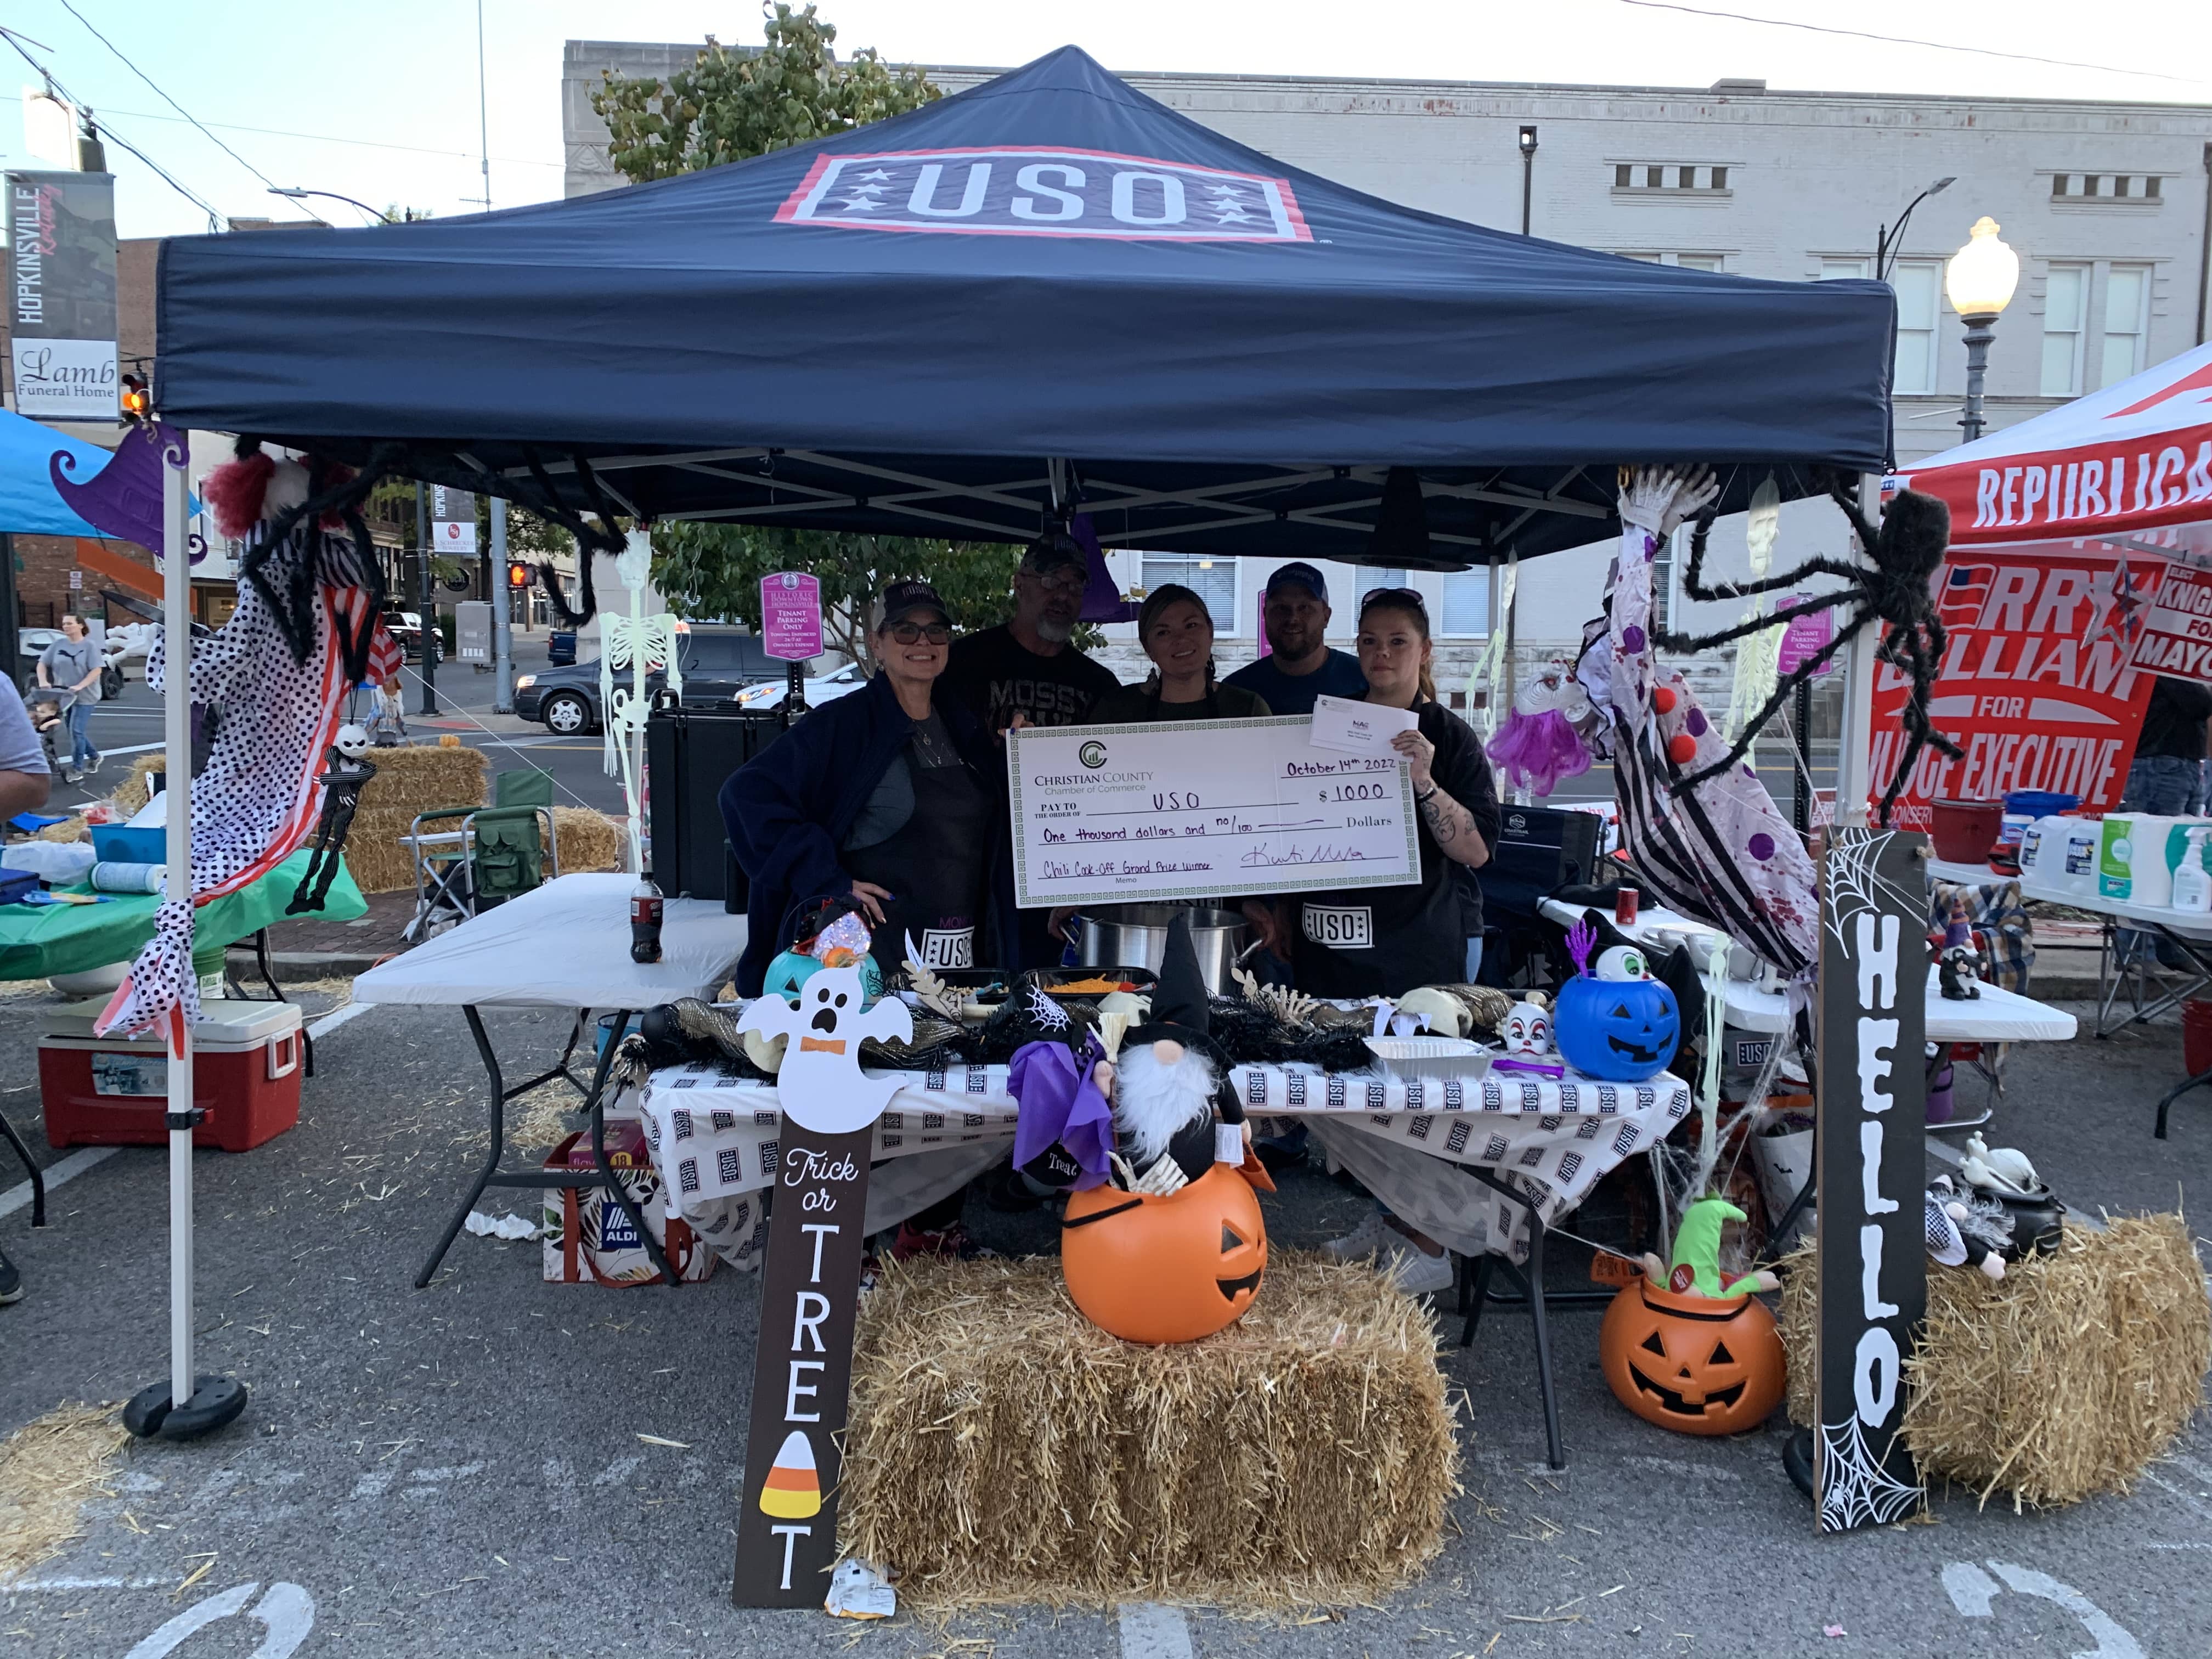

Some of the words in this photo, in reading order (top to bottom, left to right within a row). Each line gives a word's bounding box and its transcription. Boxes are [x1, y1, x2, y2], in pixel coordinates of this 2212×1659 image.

[907, 163, 1187, 225] USO
[16, 187, 43, 323] HOPKINSVILLE
[21, 348, 115, 383] Lamb
[18, 384, 71, 396] Funeral
[74, 386, 114, 397] Home
[2187, 619, 2212, 639] FO
[1978, 696, 2024, 719] FOR
[1288, 763, 1336, 776] October
[1365, 759, 1396, 770] 2022
[1961, 732, 2123, 805] EXECUTIVE
[1035, 774, 1100, 786] CHRISTIAN
[1103, 772, 1154, 782] COUNTY
[1045, 787, 1085, 795] Chamber
[1087, 786, 1096, 794] of
[1098, 784, 1146, 793] Commerce
[1153, 792, 1200, 810] USO
[1319, 790, 1327, 802] $
[1336, 784, 1383, 801] 1000
[1041, 803, 1062, 812] PAY
[1044, 828, 1066, 843] One
[1075, 827, 1126, 841] thousand
[1136, 825, 1176, 838] dollars
[1186, 823, 1205, 835] and
[1346, 816, 1392, 828] Dollars
[1044, 861, 1069, 878] Chili
[1156, 861, 1177, 872] Prize
[1314, 913, 1354, 940] USO
[939, 936, 968, 966] USO
[1250, 1076, 1265, 1098] USO
[1290, 1077, 1304, 1099] USO
[1330, 1079, 1344, 1101] USO
[1447, 1084, 1460, 1104] USO
[1486, 1084, 1500, 1105] USO
[1523, 1086, 1538, 1107] USO
[1563, 1087, 1577, 1107] USO
[1601, 1088, 1615, 1108] USO
[1670, 1089, 1688, 1114] USO
[676, 1114, 691, 1136] USO
[1449, 1126, 1468, 1149] USO
[1617, 1126, 1635, 1152] USO
[721, 1155, 737, 1177] USO
[785, 1148, 859, 1187] Trick
[1048, 1152, 1077, 1176] Treat
[1561, 1156, 1579, 1180] USO
[1854, 911, 1903, 1429] HELLO
[681, 1165, 697, 1188] USO
[803, 1190, 837, 1212] or
[606, 1231, 637, 1242] ALDI
